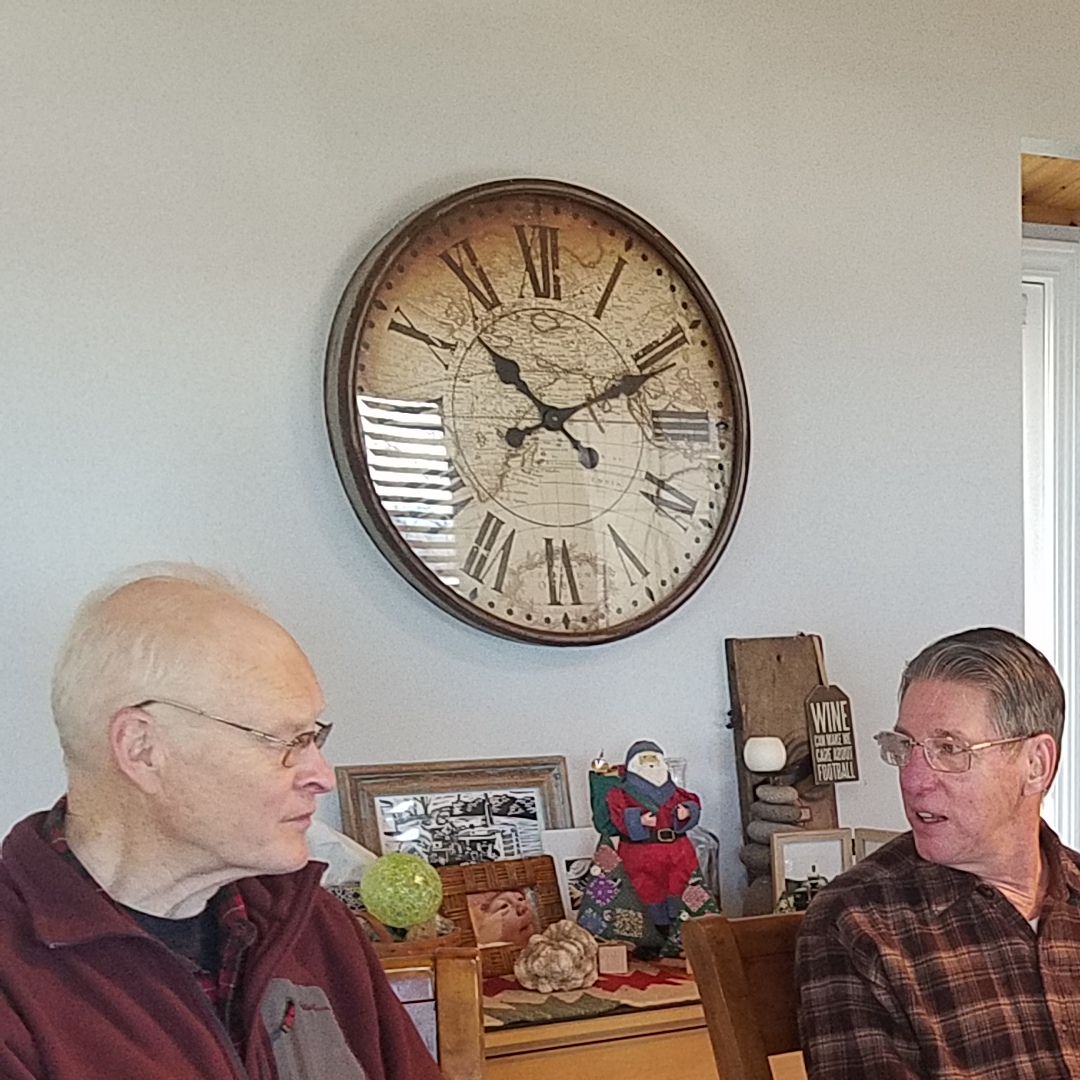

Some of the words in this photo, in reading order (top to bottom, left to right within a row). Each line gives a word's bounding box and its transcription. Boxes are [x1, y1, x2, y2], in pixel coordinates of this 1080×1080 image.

[438, 238, 501, 321] XI
[513, 225, 561, 300] XII
[593, 257, 628, 320] I
[387, 306, 458, 371] X
[631, 324, 690, 376] II
[652, 410, 710, 442] III
[541, 537, 583, 606] VI
[608, 524, 651, 587] V
[810, 700, 850, 733] WINE
[817, 762, 856, 781] FOOTBALL
